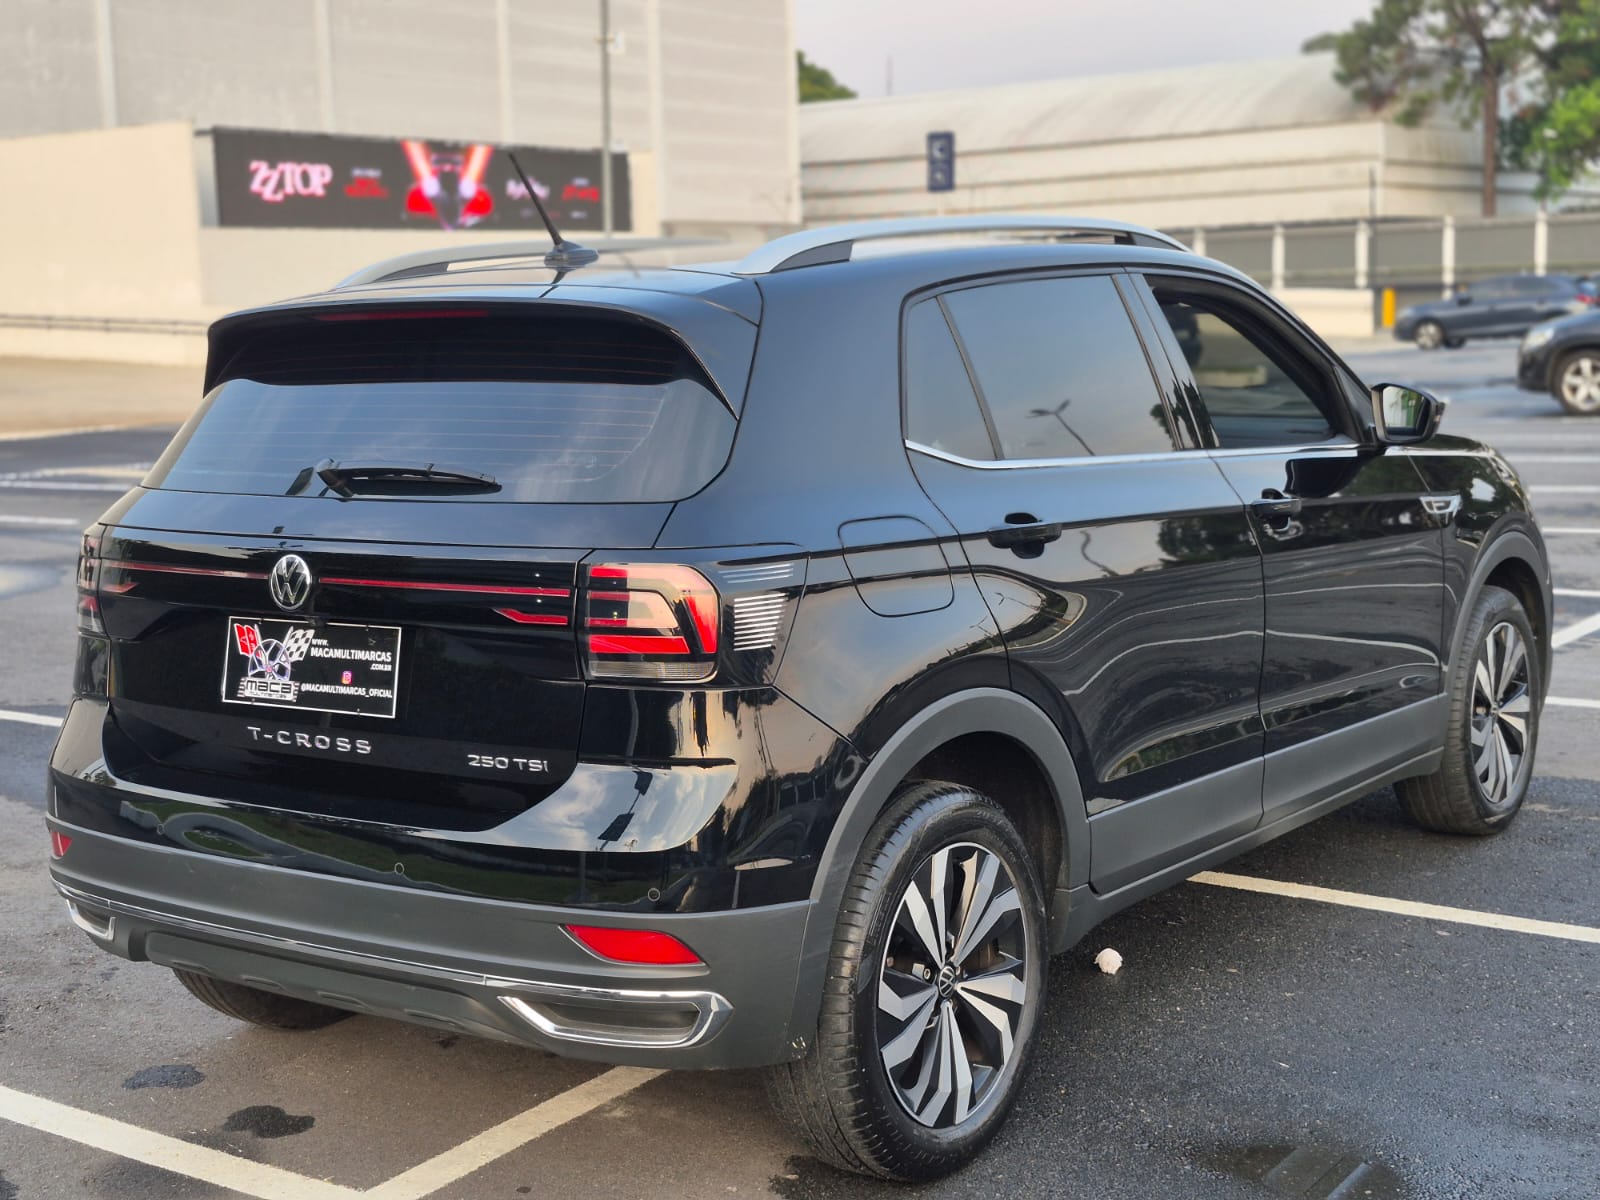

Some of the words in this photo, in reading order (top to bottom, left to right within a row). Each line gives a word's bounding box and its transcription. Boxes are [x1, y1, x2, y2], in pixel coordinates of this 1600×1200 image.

[310, 646, 392, 663] MACAMULTIMARCAS
[300, 682, 393, 699] @MACAMULTIMARCAS_OFICIAL
[247, 726, 372, 754] T-CROSS
[467, 754, 509, 769] 250
[512, 758, 549, 773] TSI
